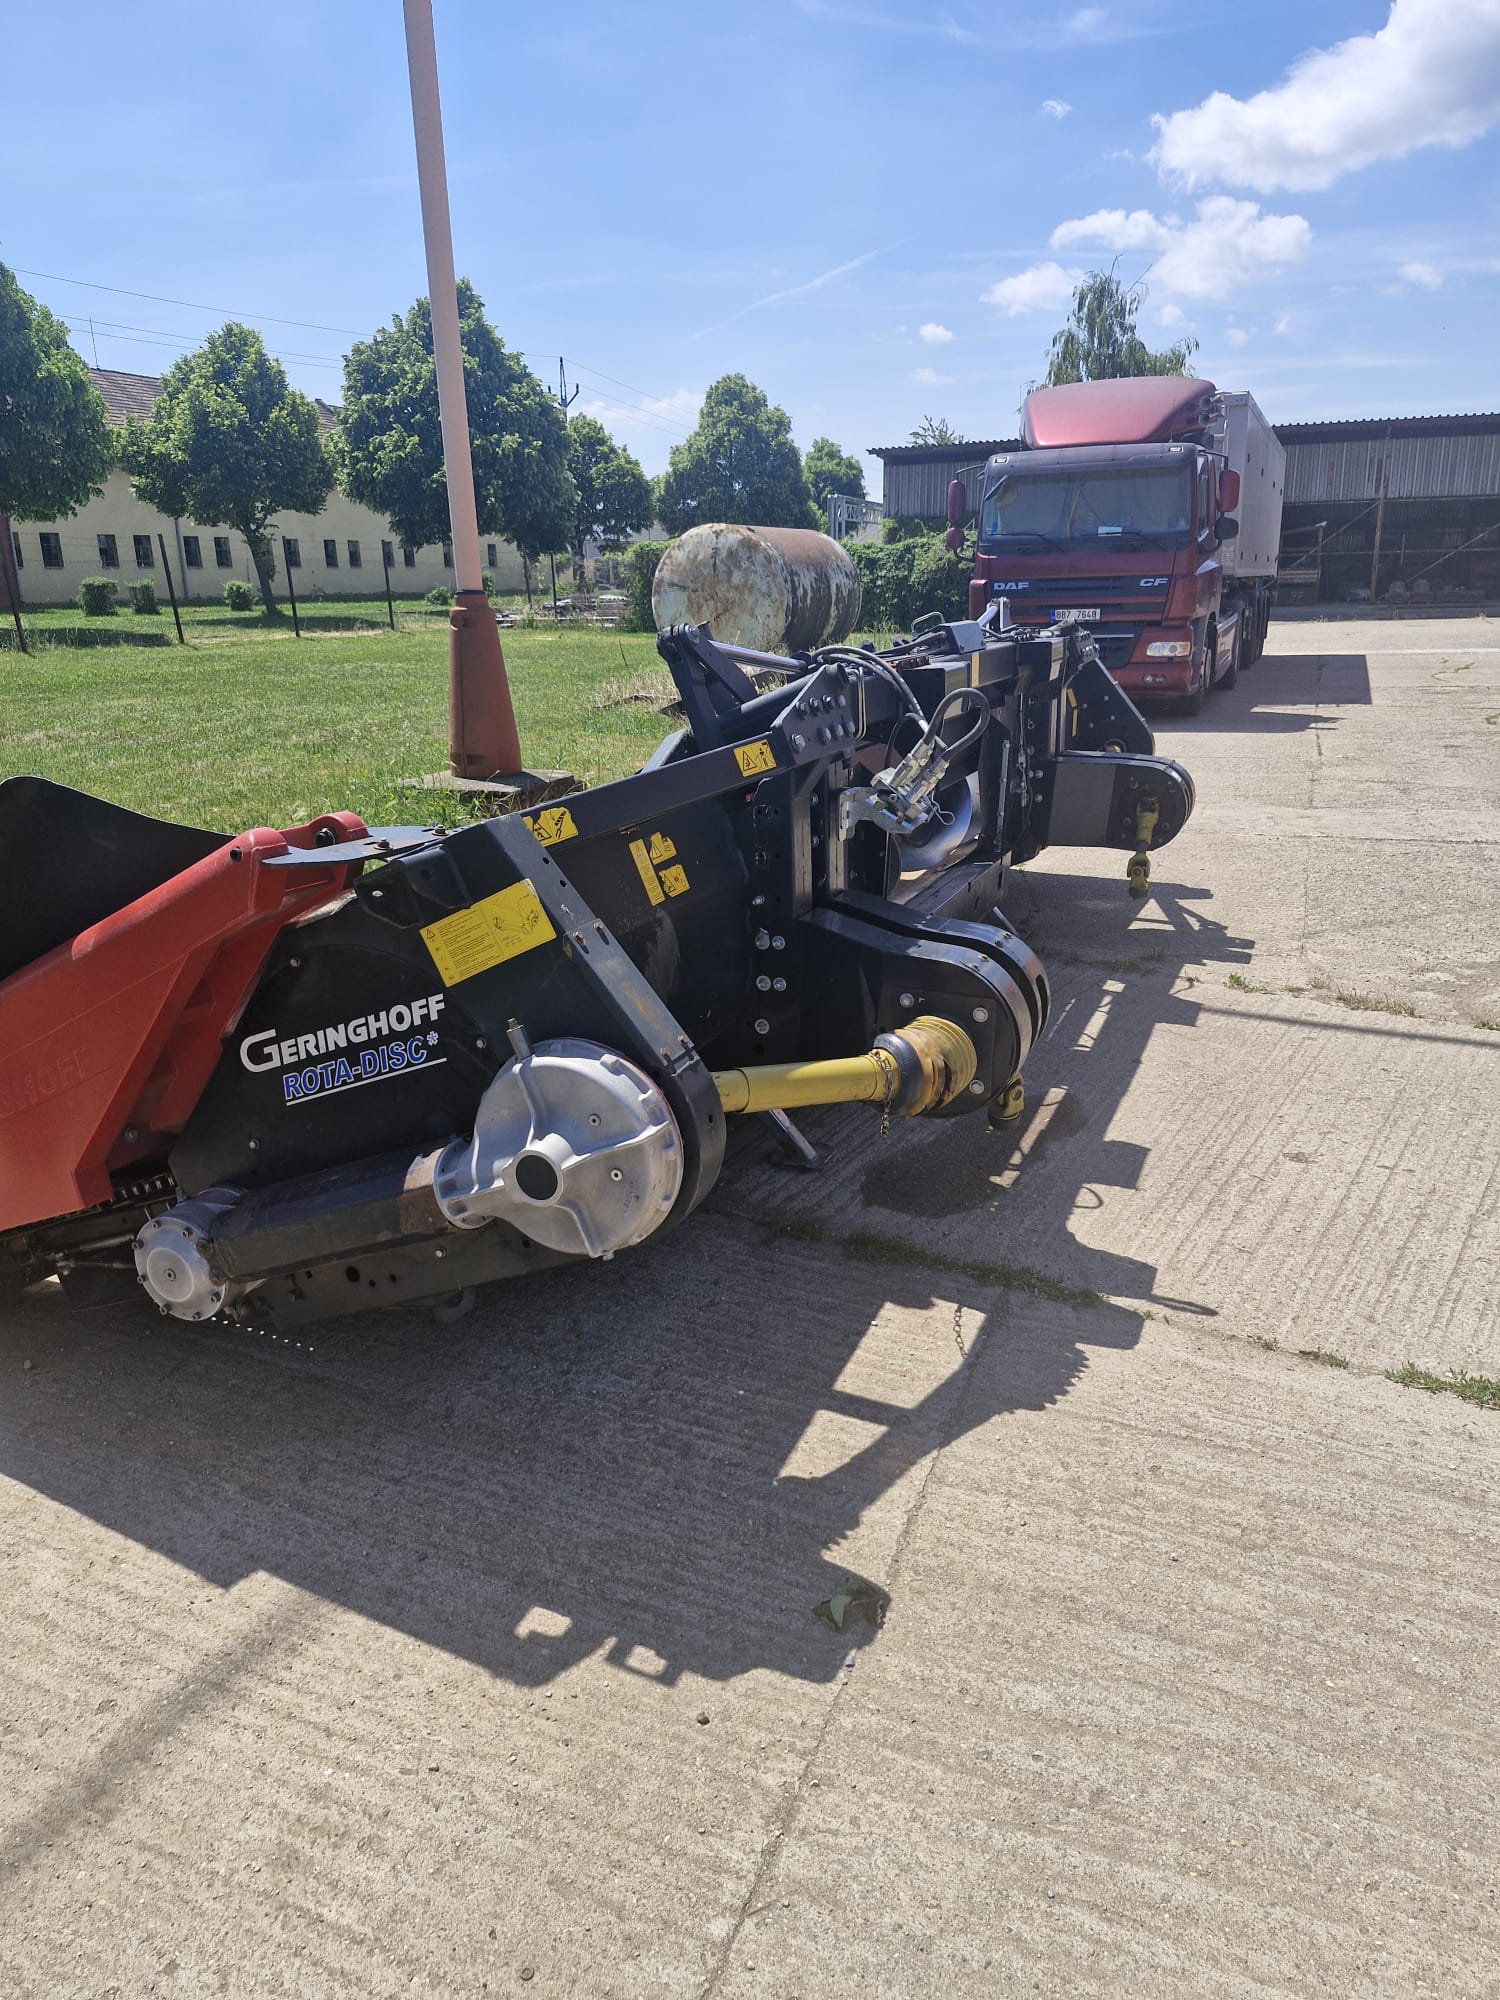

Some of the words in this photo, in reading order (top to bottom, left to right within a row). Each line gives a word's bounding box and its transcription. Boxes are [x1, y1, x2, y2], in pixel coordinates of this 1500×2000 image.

[993, 581, 1029, 591] DAF
[1139, 577, 1169, 588] CF
[240, 992, 446, 1073] GERINGHOFF
[282, 1035, 428, 1101] ROTA-DISC
